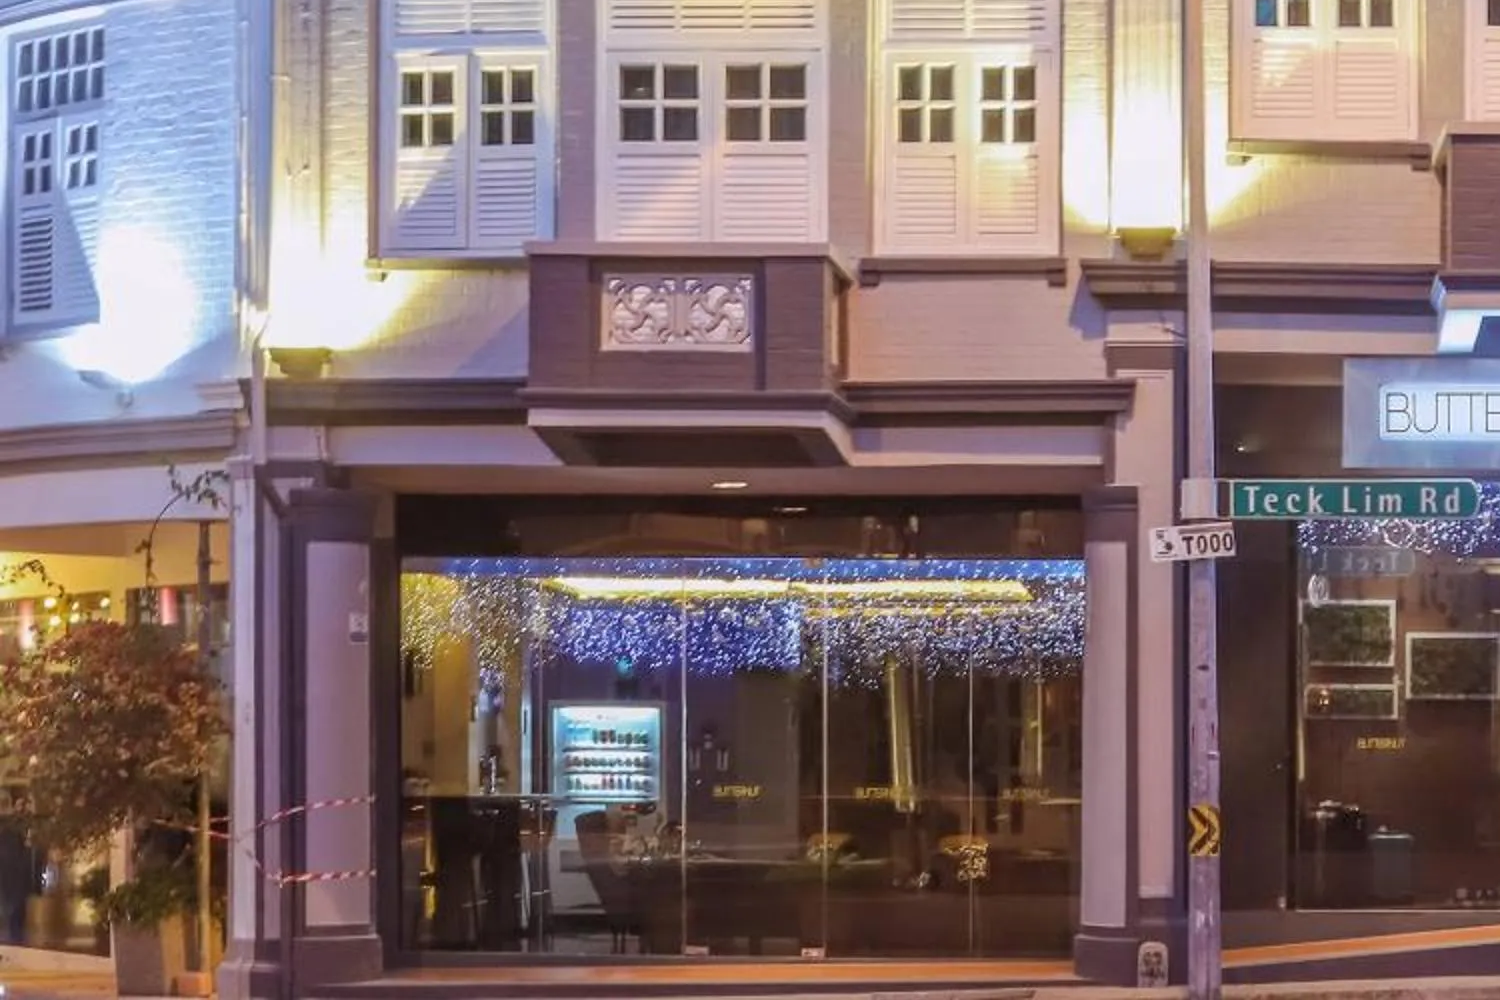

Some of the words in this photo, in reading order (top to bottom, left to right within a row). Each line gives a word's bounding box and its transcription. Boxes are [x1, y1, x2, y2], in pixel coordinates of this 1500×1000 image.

[1241, 485, 1325, 514] Teck
[1342, 486, 1403, 514] Lim
[1420, 486, 1461, 514] Rd
